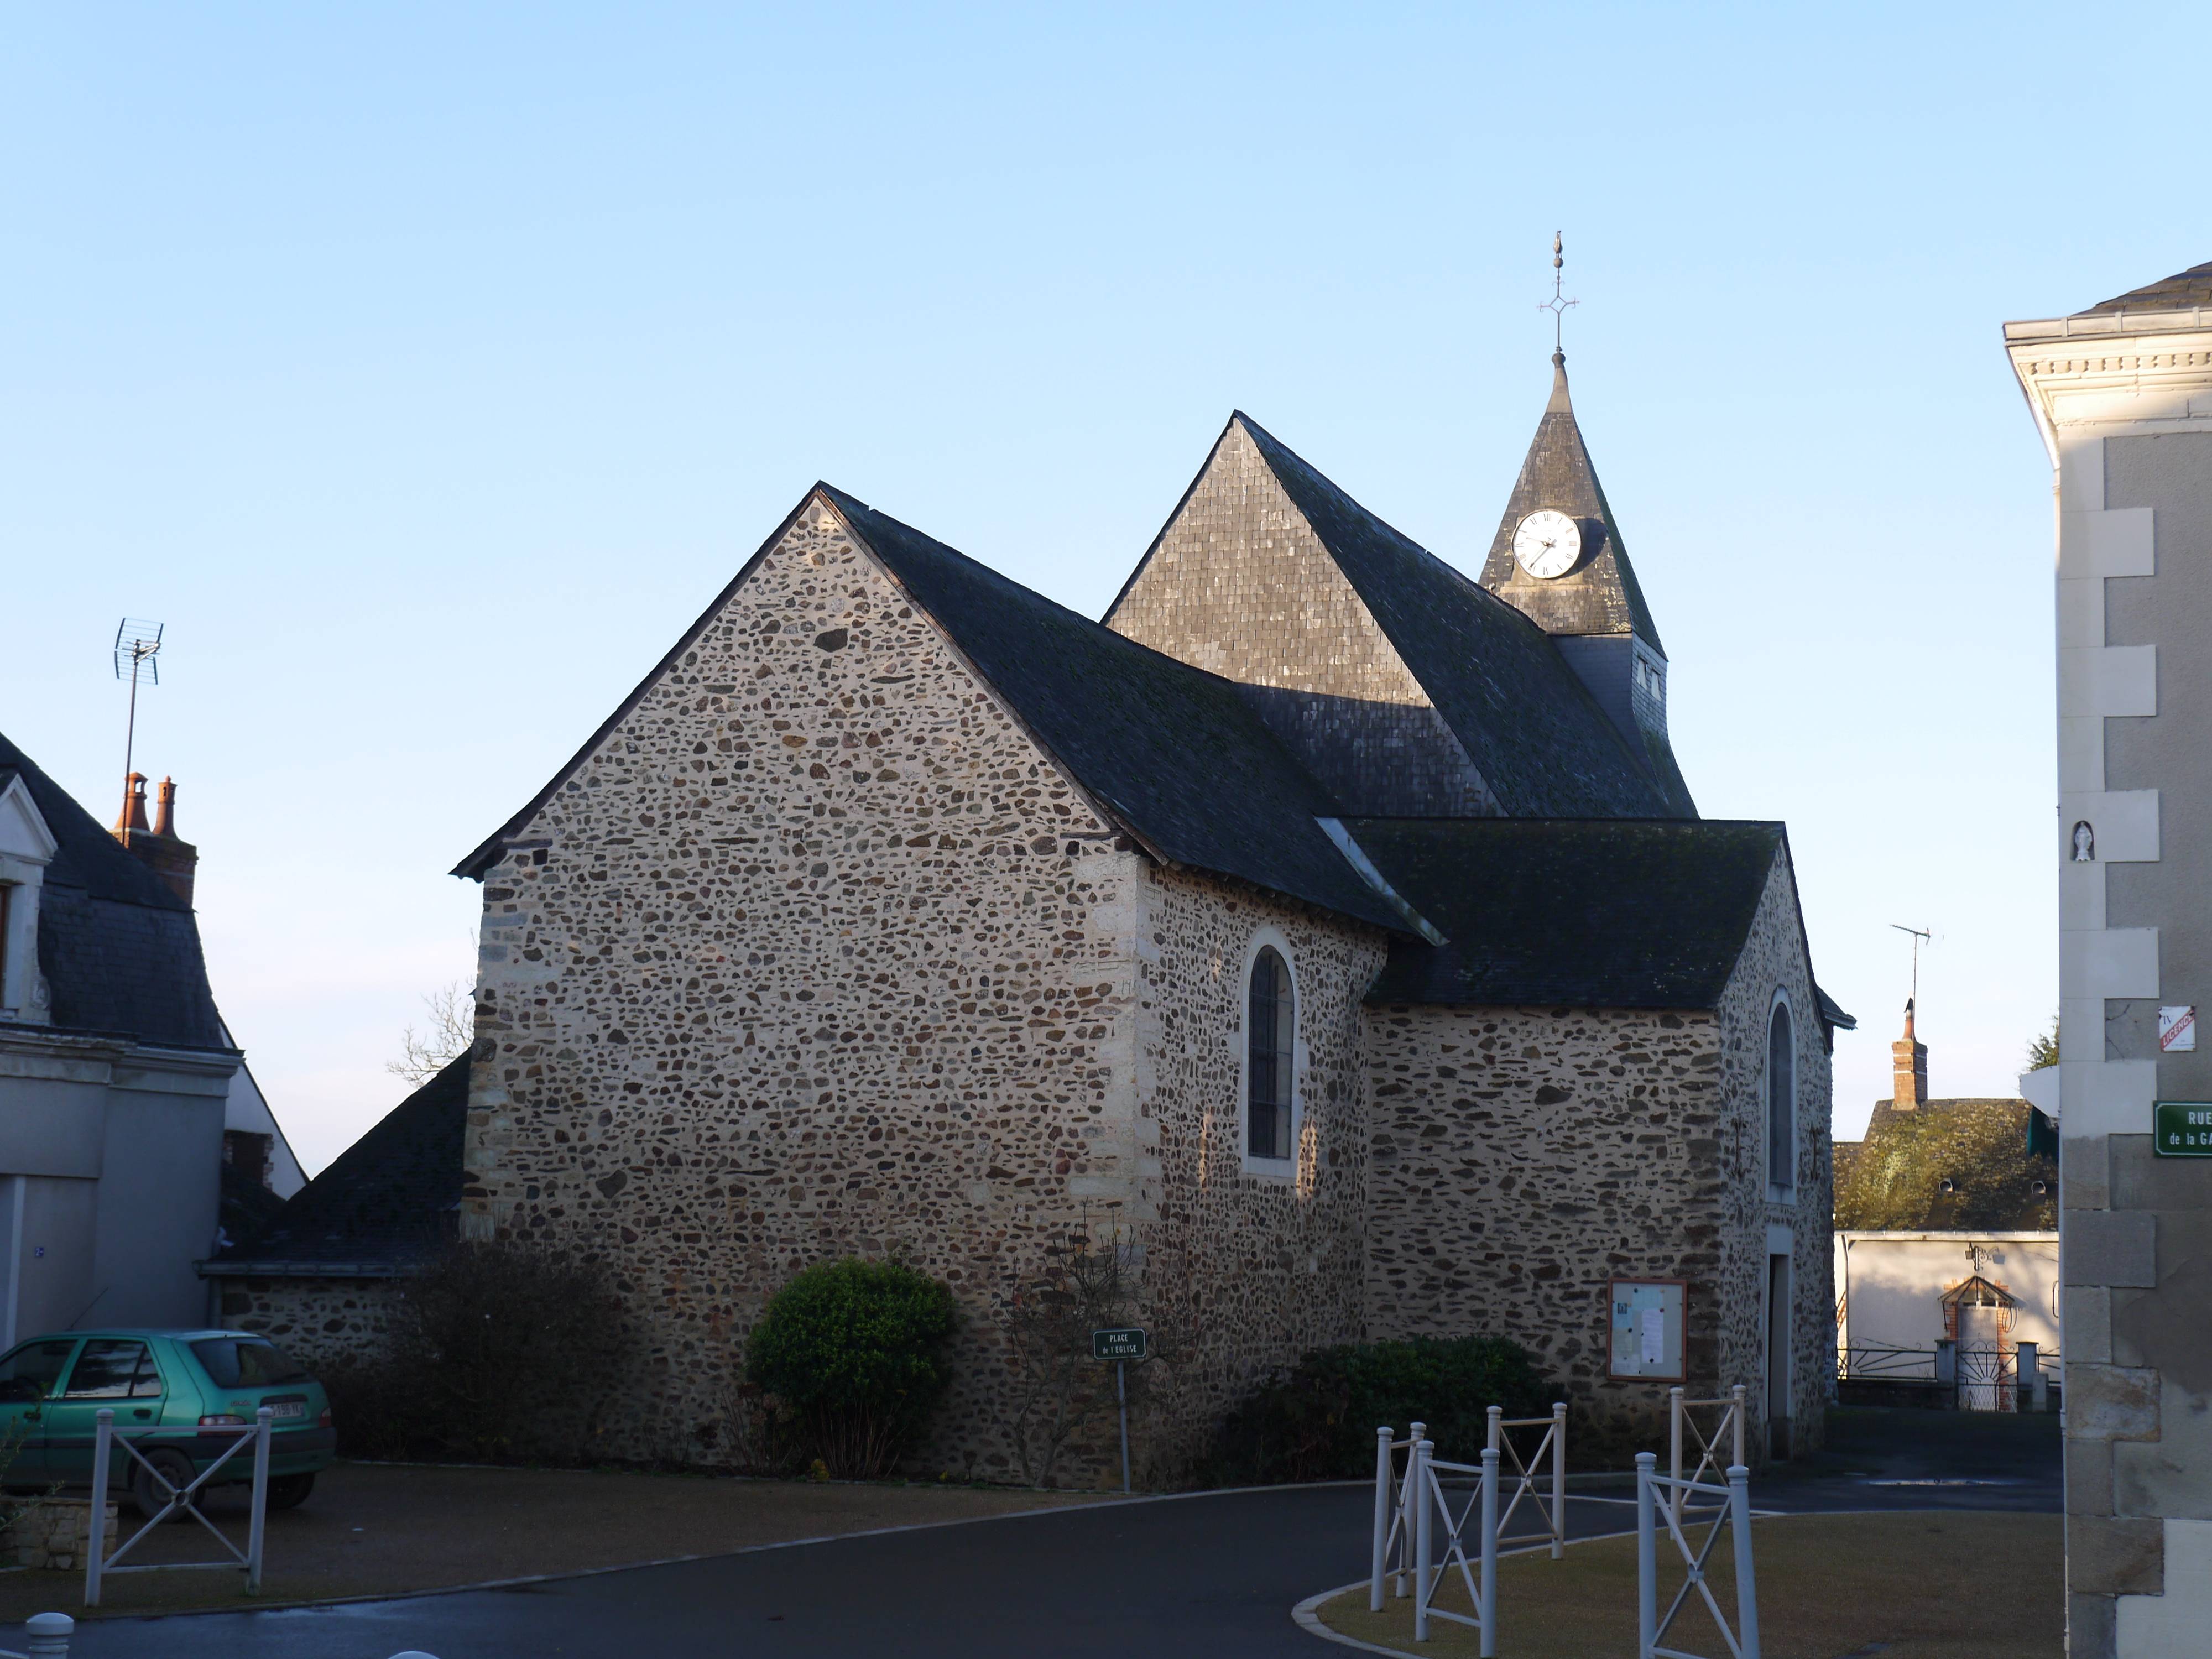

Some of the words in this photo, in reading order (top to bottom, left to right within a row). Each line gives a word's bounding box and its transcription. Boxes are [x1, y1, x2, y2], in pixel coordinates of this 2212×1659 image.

[2189, 1112, 2212, 1125] RUE
[2169, 1132, 2180, 1145] de
[2187, 1132, 2195, 1145] la
[1109, 1334, 1129, 1343] PLACE
[1103, 1346, 1108, 1354] de
